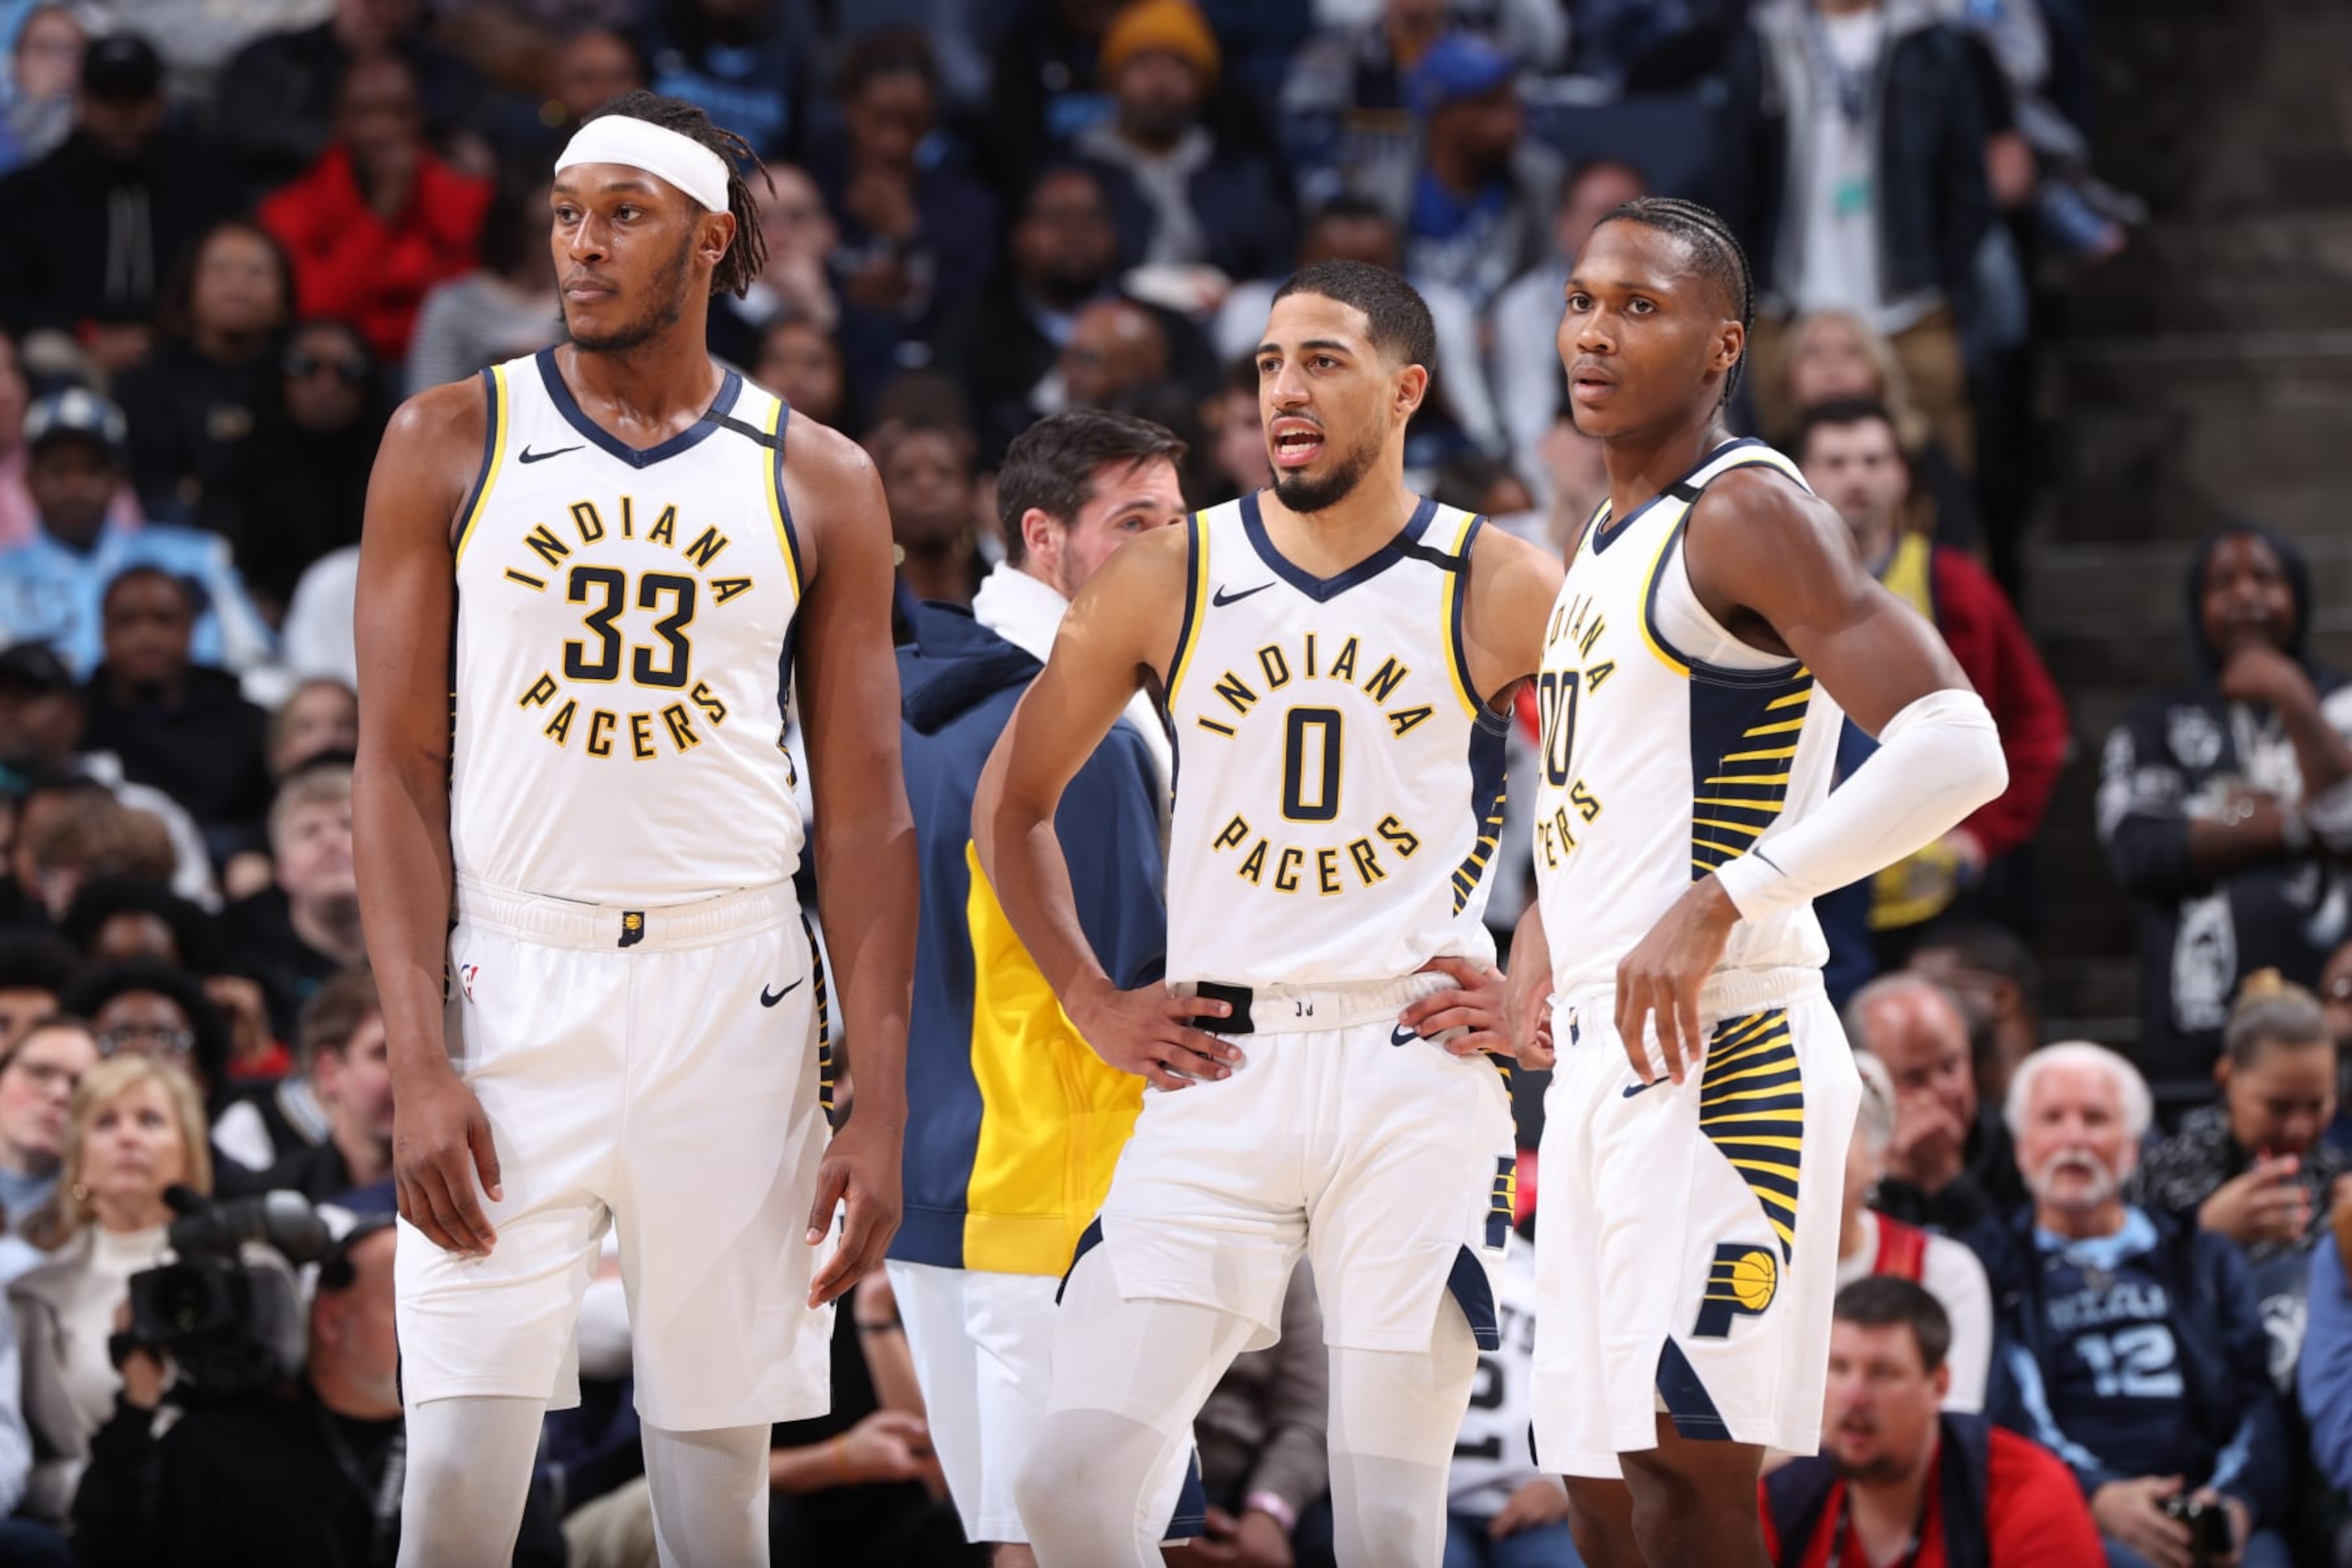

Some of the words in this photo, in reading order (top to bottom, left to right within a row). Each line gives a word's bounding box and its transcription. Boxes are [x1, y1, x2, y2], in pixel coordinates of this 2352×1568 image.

[503, 496, 754, 606] INDIANA
[561, 564, 699, 691] 33
[1540, 592, 1616, 695] DIANA
[518, 671, 728, 761] PACERS
[1197, 632, 1436, 740] INDIANA
[1280, 705, 1344, 824] 0
[1212, 813, 1422, 896] PACERS
[1538, 778, 1602, 870] ERS
[2075, 1322, 2185, 1399] 12
